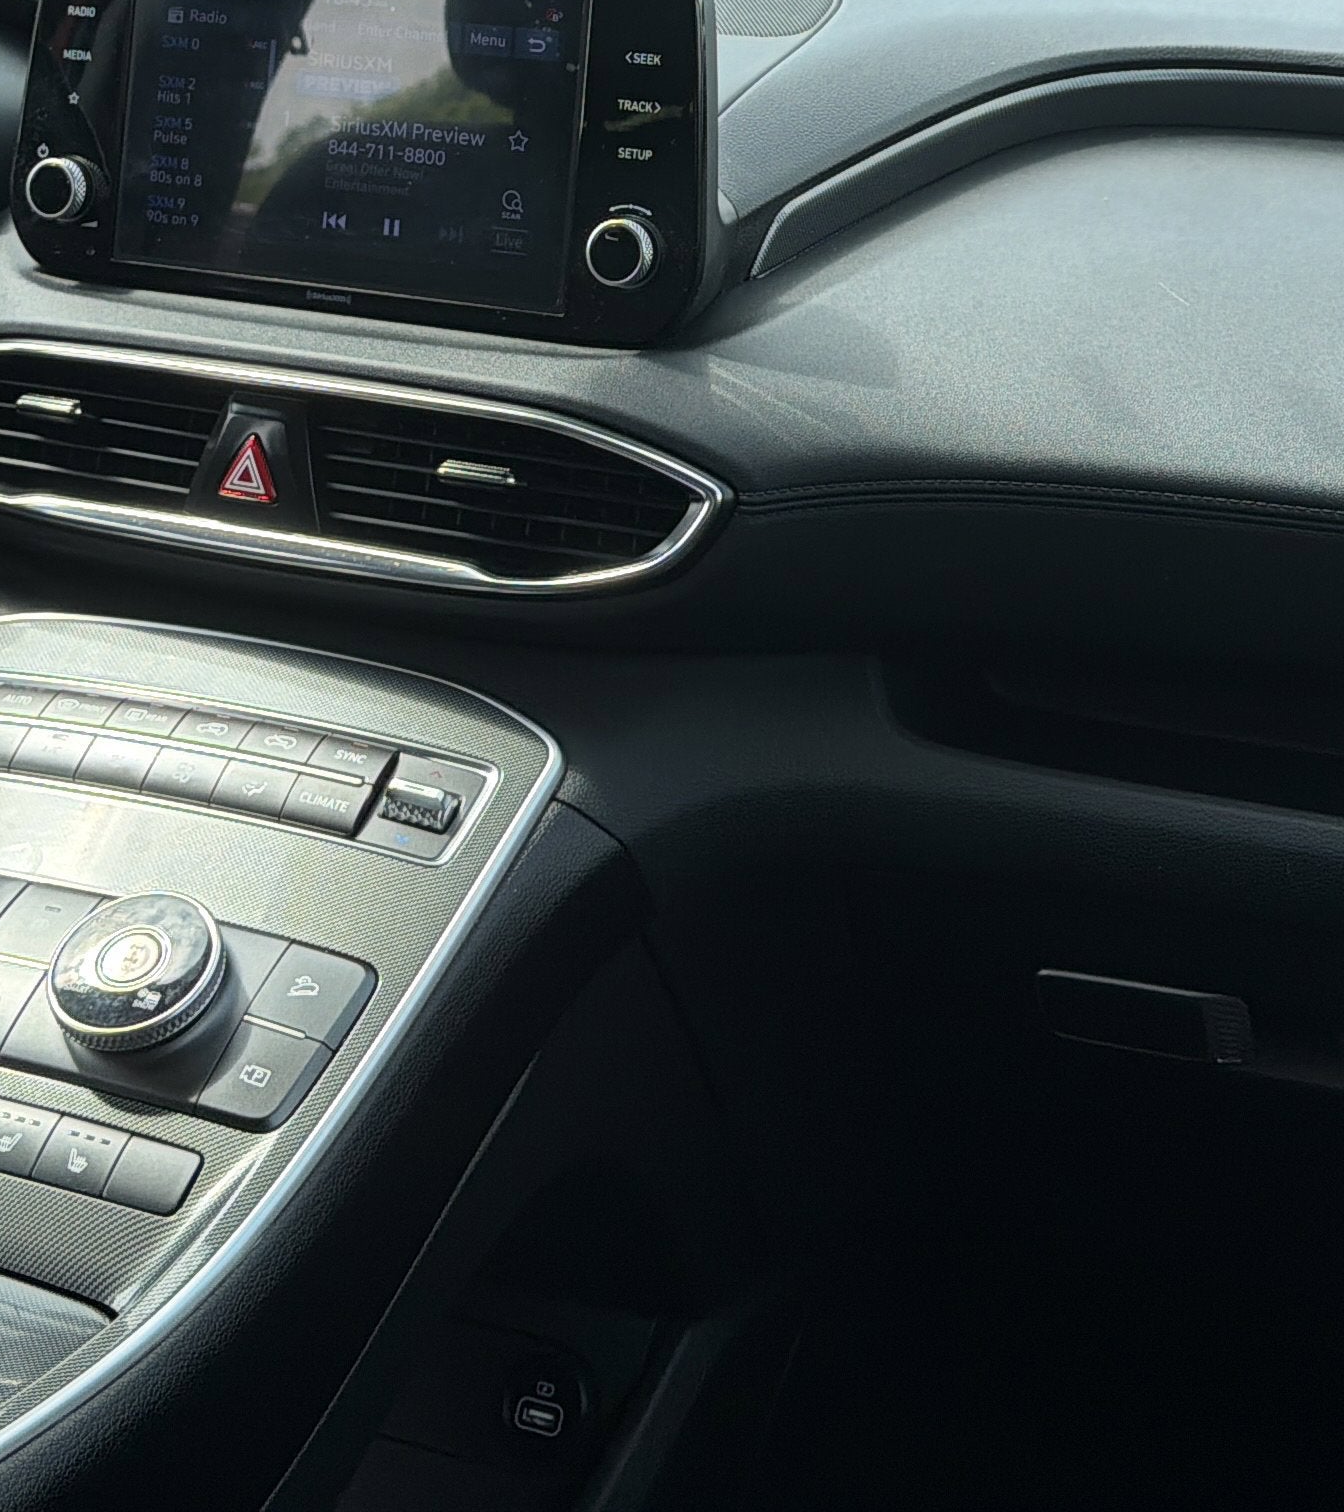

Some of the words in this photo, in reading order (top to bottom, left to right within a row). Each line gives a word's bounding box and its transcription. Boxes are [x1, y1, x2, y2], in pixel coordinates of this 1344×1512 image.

[67, 5, 96, 18] RADIO
[189, 9, 228, 25] Radio
[160, 34, 190, 48] SXM
[469, 31, 507, 49] Menu
[62, 48, 93, 63] MEDIA
[308, 50, 393, 74] SIRIUSXM
[632, 52, 663, 67] SEEK
[157, 73, 187, 88] SXM
[187, 77, 197, 90] 2
[156, 90, 182, 105] Hits
[617, 98, 654, 114] TRACK
[155, 115, 184, 129] SXM
[184, 117, 193, 131] 5
[329, 114, 408, 138] SiriusXM
[411, 123, 486, 148] Preview
[153, 130, 189, 146] Pulse
[327, 139, 447, 167] 844-711-8800
[617, 146, 654, 162] SETUP
[149, 169, 173, 185] 80s
[175, 173, 191, 186] on
[192, 173, 203, 188] 8
[147, 194, 175, 209] SXM
[176, 196, 186, 211] 9
[145, 208, 170, 225] 90s
[171, 213, 188, 226] on
[189, 213, 200, 228] 9
[495, 230, 523, 248] Live
[3, 693, 34, 705] AUTO
[334, 749, 368, 765] SYNC
[298, 791, 351, 813] CLIMATE
